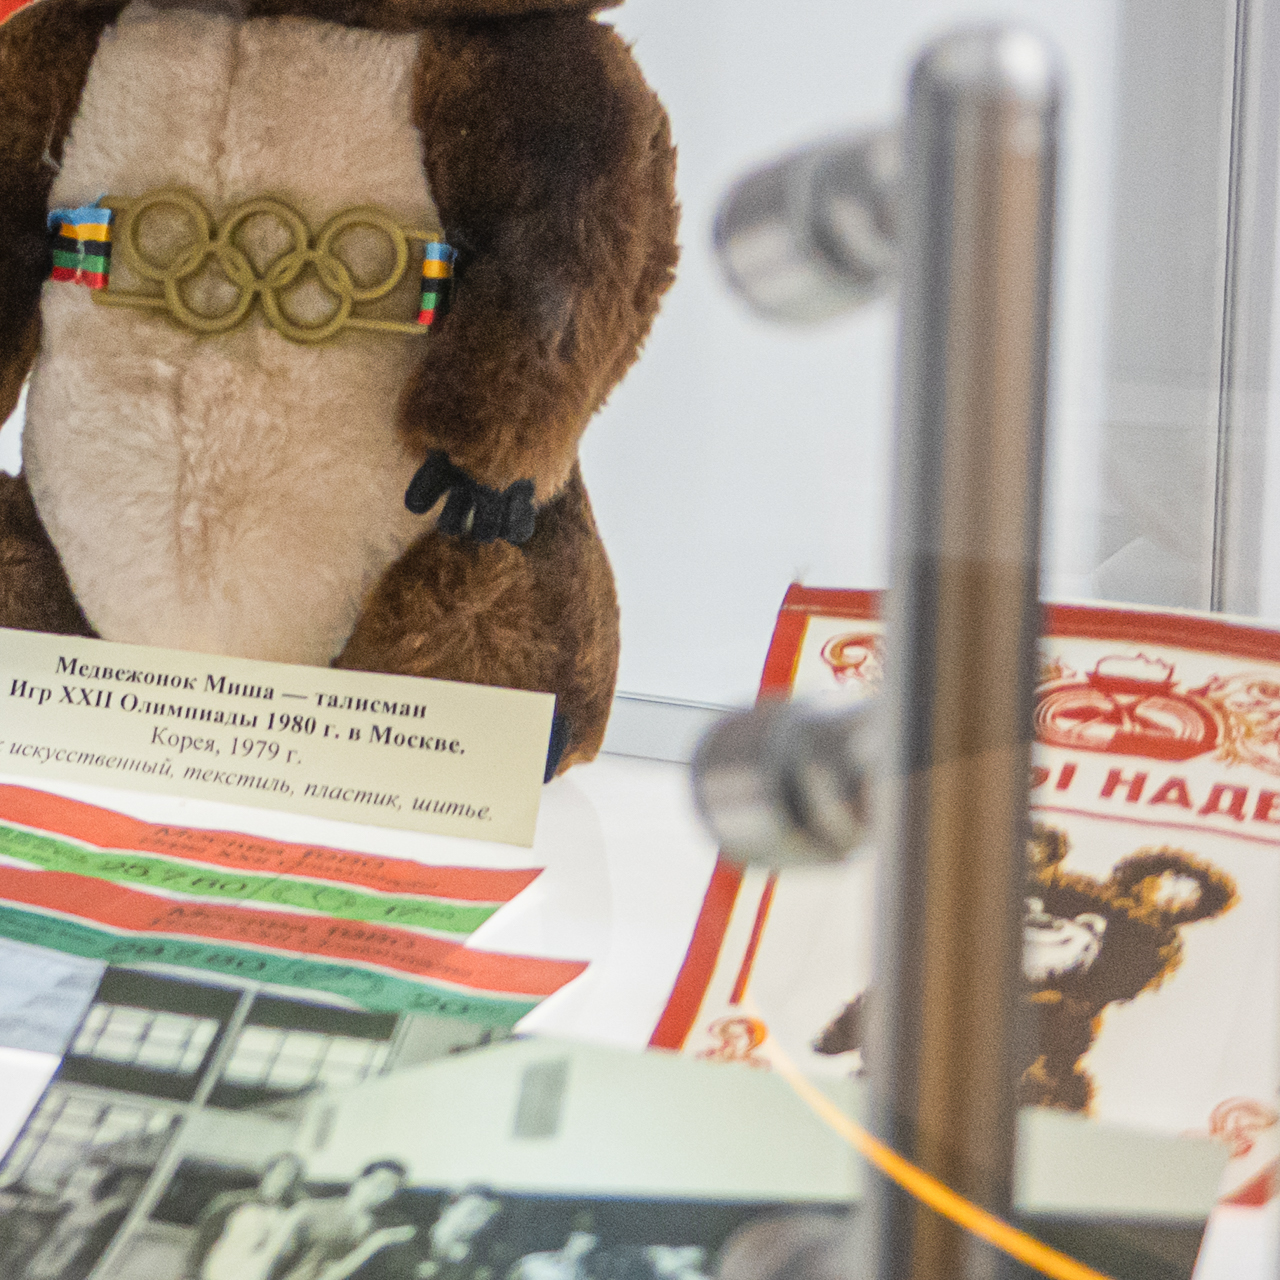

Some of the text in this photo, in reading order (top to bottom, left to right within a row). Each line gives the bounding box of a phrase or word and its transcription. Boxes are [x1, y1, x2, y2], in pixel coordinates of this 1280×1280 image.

[9, 678, 466, 755] Игр XXII Олимпиады 1980 г. в Москве.
[54, 656, 197, 690] Медвежонок
[203, 673, 275, 701] Миша
[315, 691, 428, 719] талисман
[151, 725, 302, 765] Корея, 1979 г.
[9, 742, 174, 779] искусственный,
[182, 764, 295, 797] текстиль,
[303, 781, 402, 810] пластик,
[411, 795, 493, 822] шитье.
